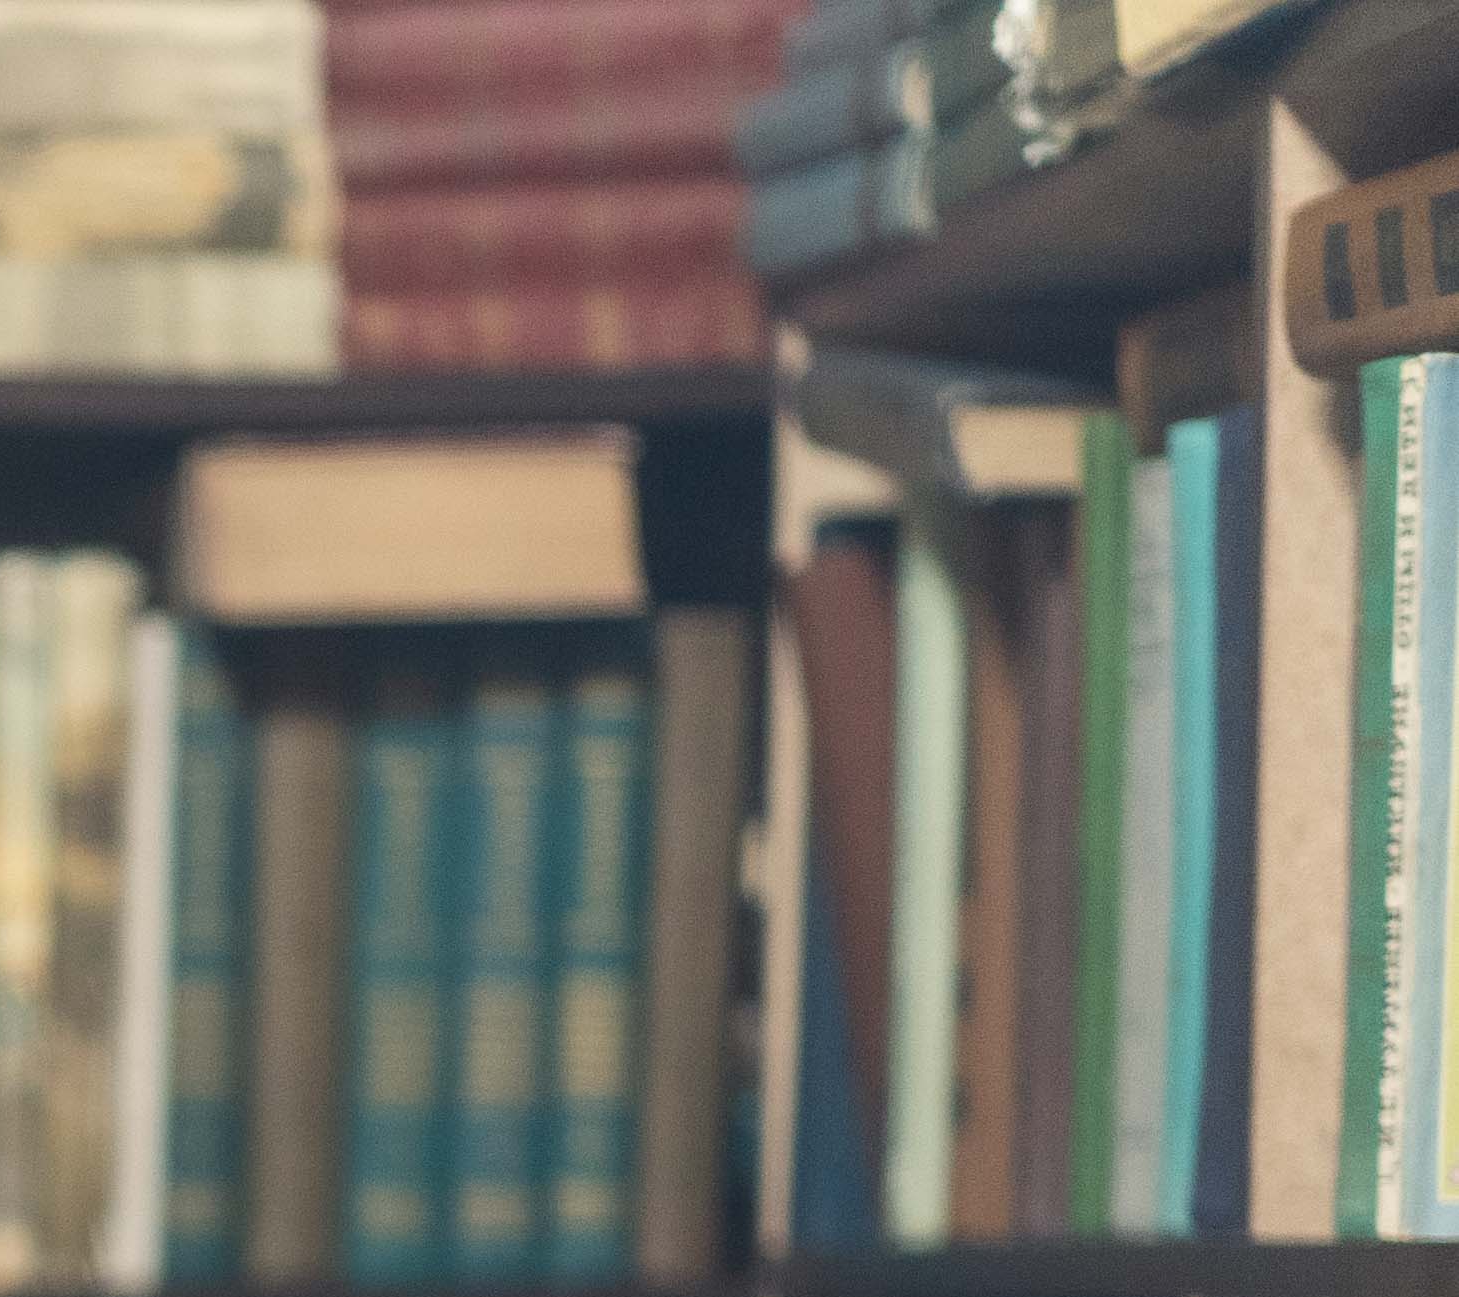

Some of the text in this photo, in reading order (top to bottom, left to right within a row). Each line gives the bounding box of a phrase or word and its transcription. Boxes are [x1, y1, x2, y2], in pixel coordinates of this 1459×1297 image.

[1402, 405, 1417, 498] ДЕТИ
[1400, 514, 1414, 537] И
[1397, 548, 1414, 650] ОТЦЫ
